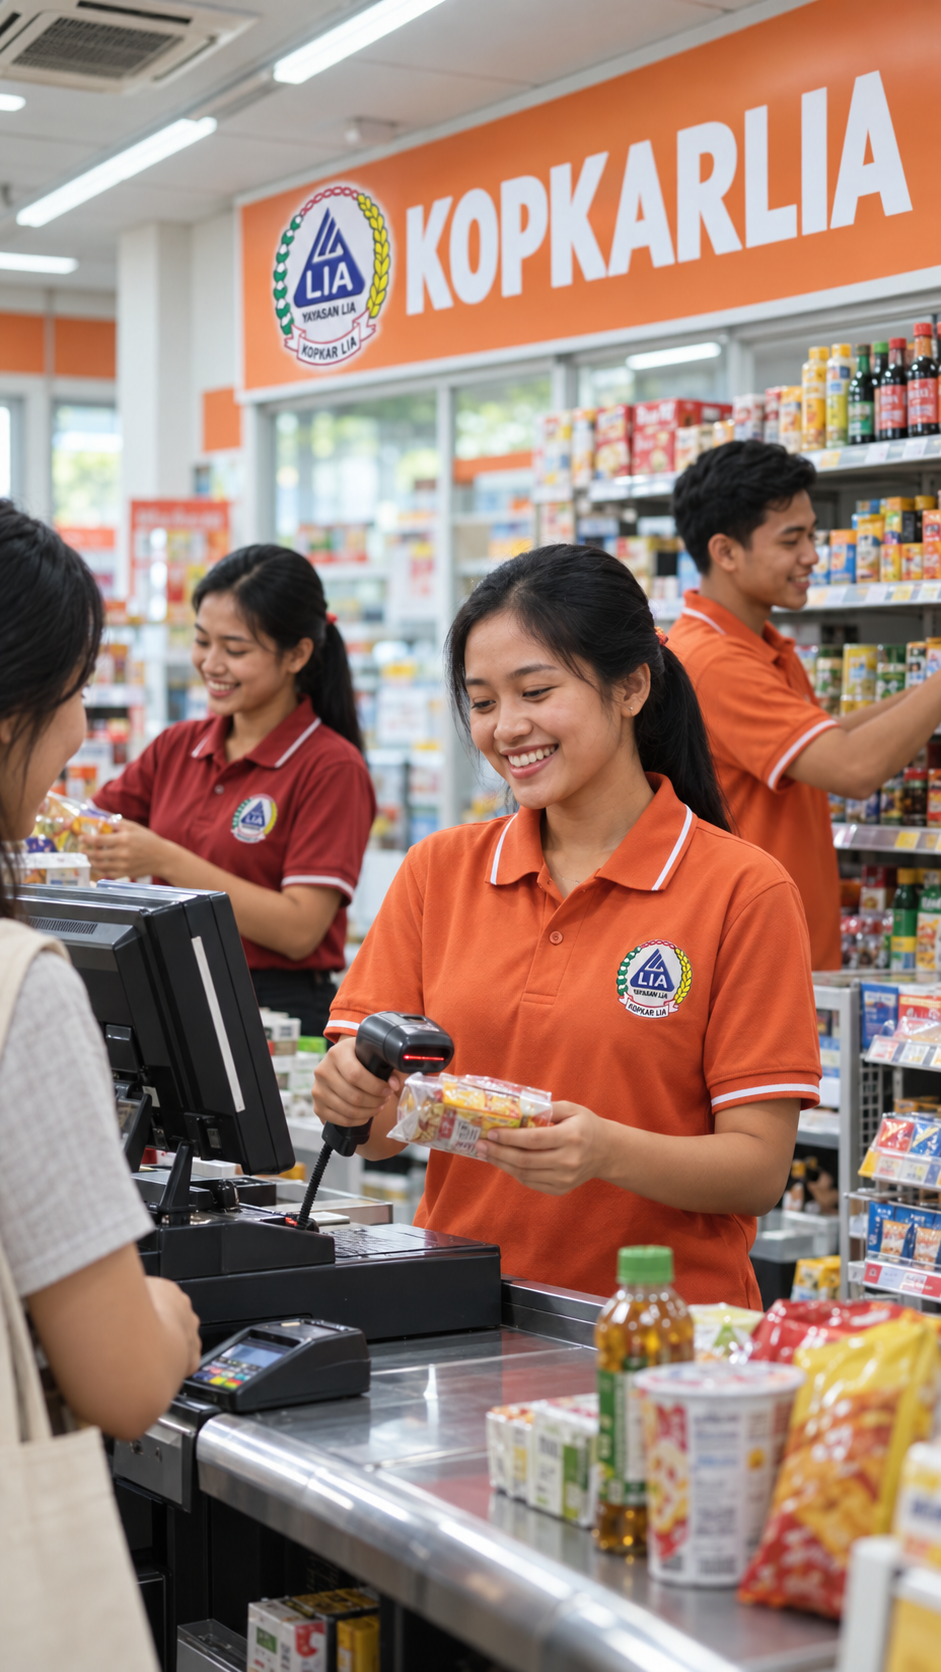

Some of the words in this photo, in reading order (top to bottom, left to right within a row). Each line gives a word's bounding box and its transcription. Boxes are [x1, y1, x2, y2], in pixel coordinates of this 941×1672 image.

[406, 70, 913, 316] KOPKARLIA
[306, 261, 353, 299] LIA
[302, 305, 339, 324] YAYASAN
[341, 301, 356, 315] LIA
[301, 344, 338, 360] KOPKAR
[341, 336, 356, 355] LIA
[245, 814, 262, 825] LIA
[637, 972, 667, 988] LIA
[656, 1008, 666, 1016] LIA
